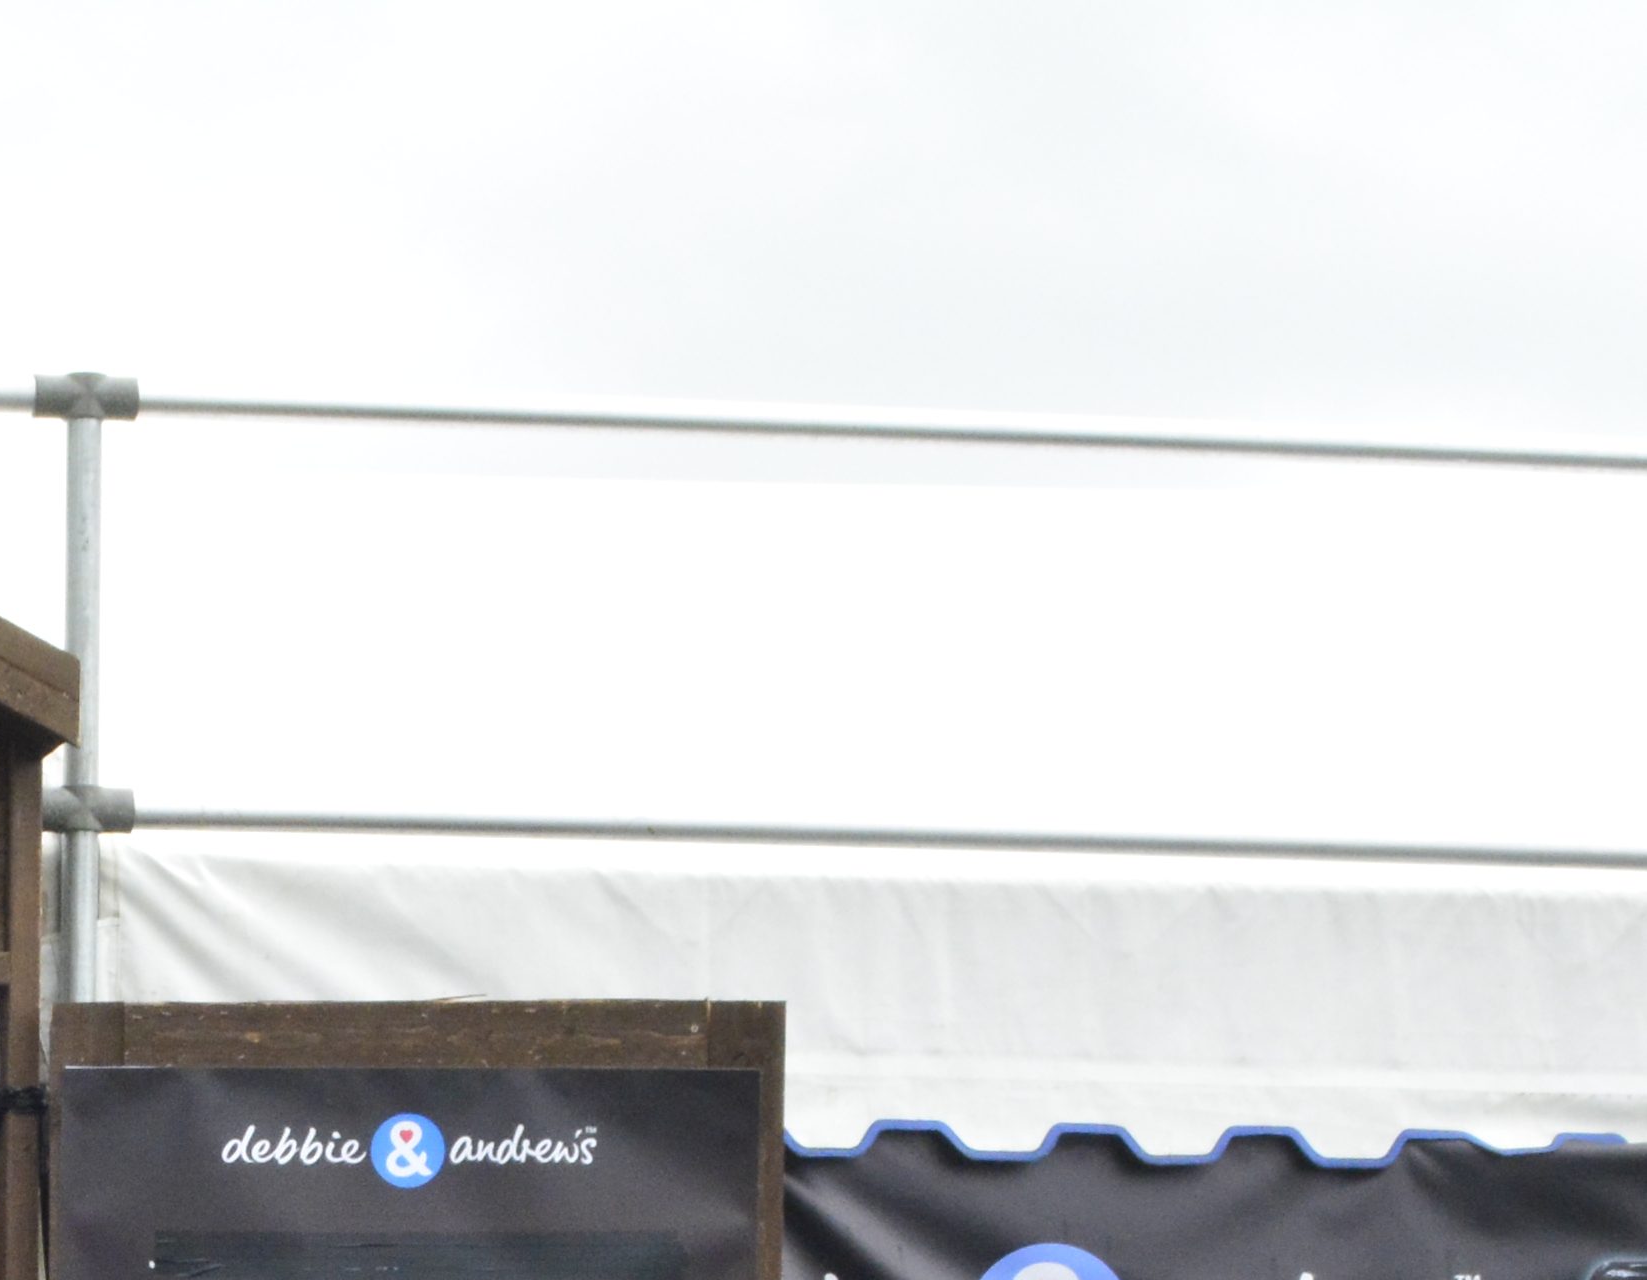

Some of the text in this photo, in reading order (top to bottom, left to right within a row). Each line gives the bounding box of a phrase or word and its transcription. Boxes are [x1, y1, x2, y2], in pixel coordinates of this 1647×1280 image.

[221, 1118, 598, 1178] debbie & andrew's
